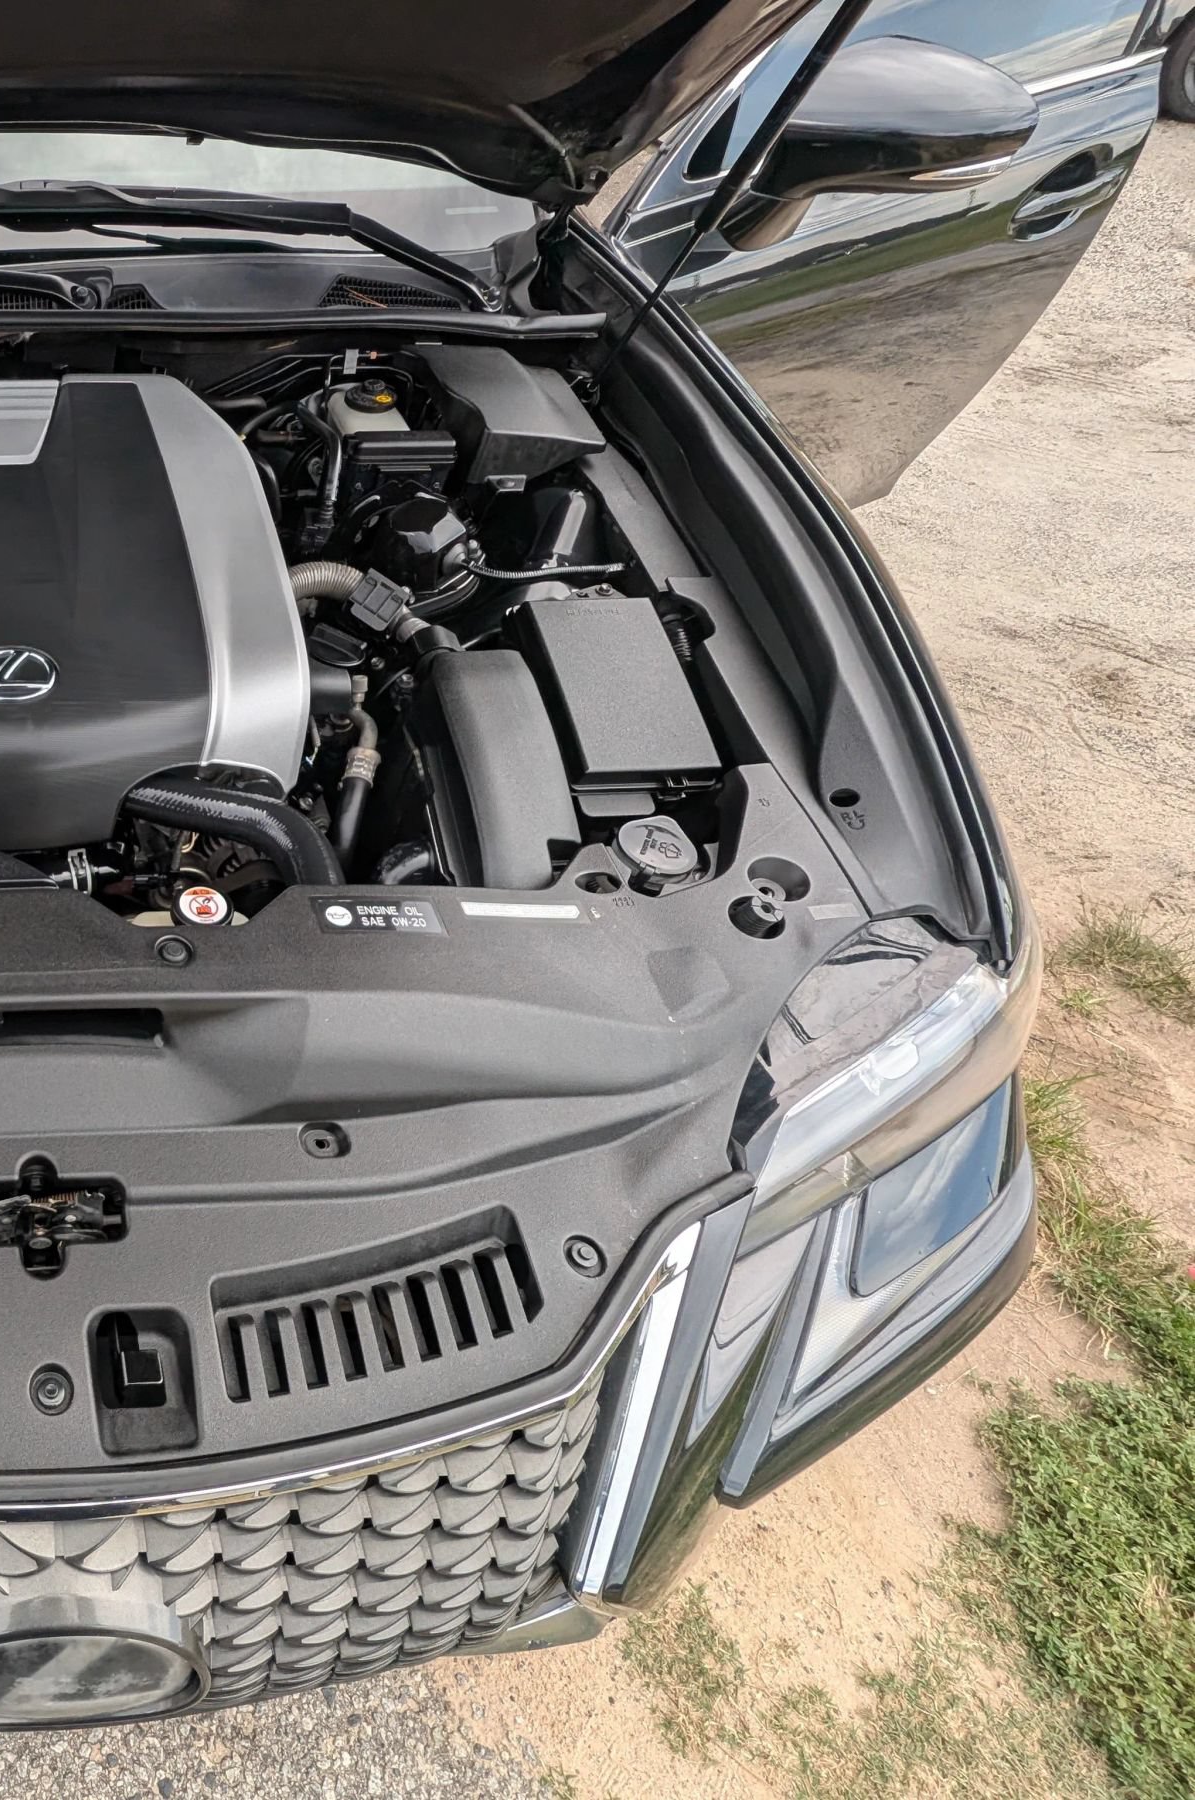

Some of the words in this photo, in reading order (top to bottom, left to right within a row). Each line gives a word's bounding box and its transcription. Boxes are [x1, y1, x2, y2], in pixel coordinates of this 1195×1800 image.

[356, 905, 399, 916] ENGINE
[404, 906, 423, 916] OIL
[361, 916, 386, 927] SAE
[391, 917, 427, 928] 0W-20
